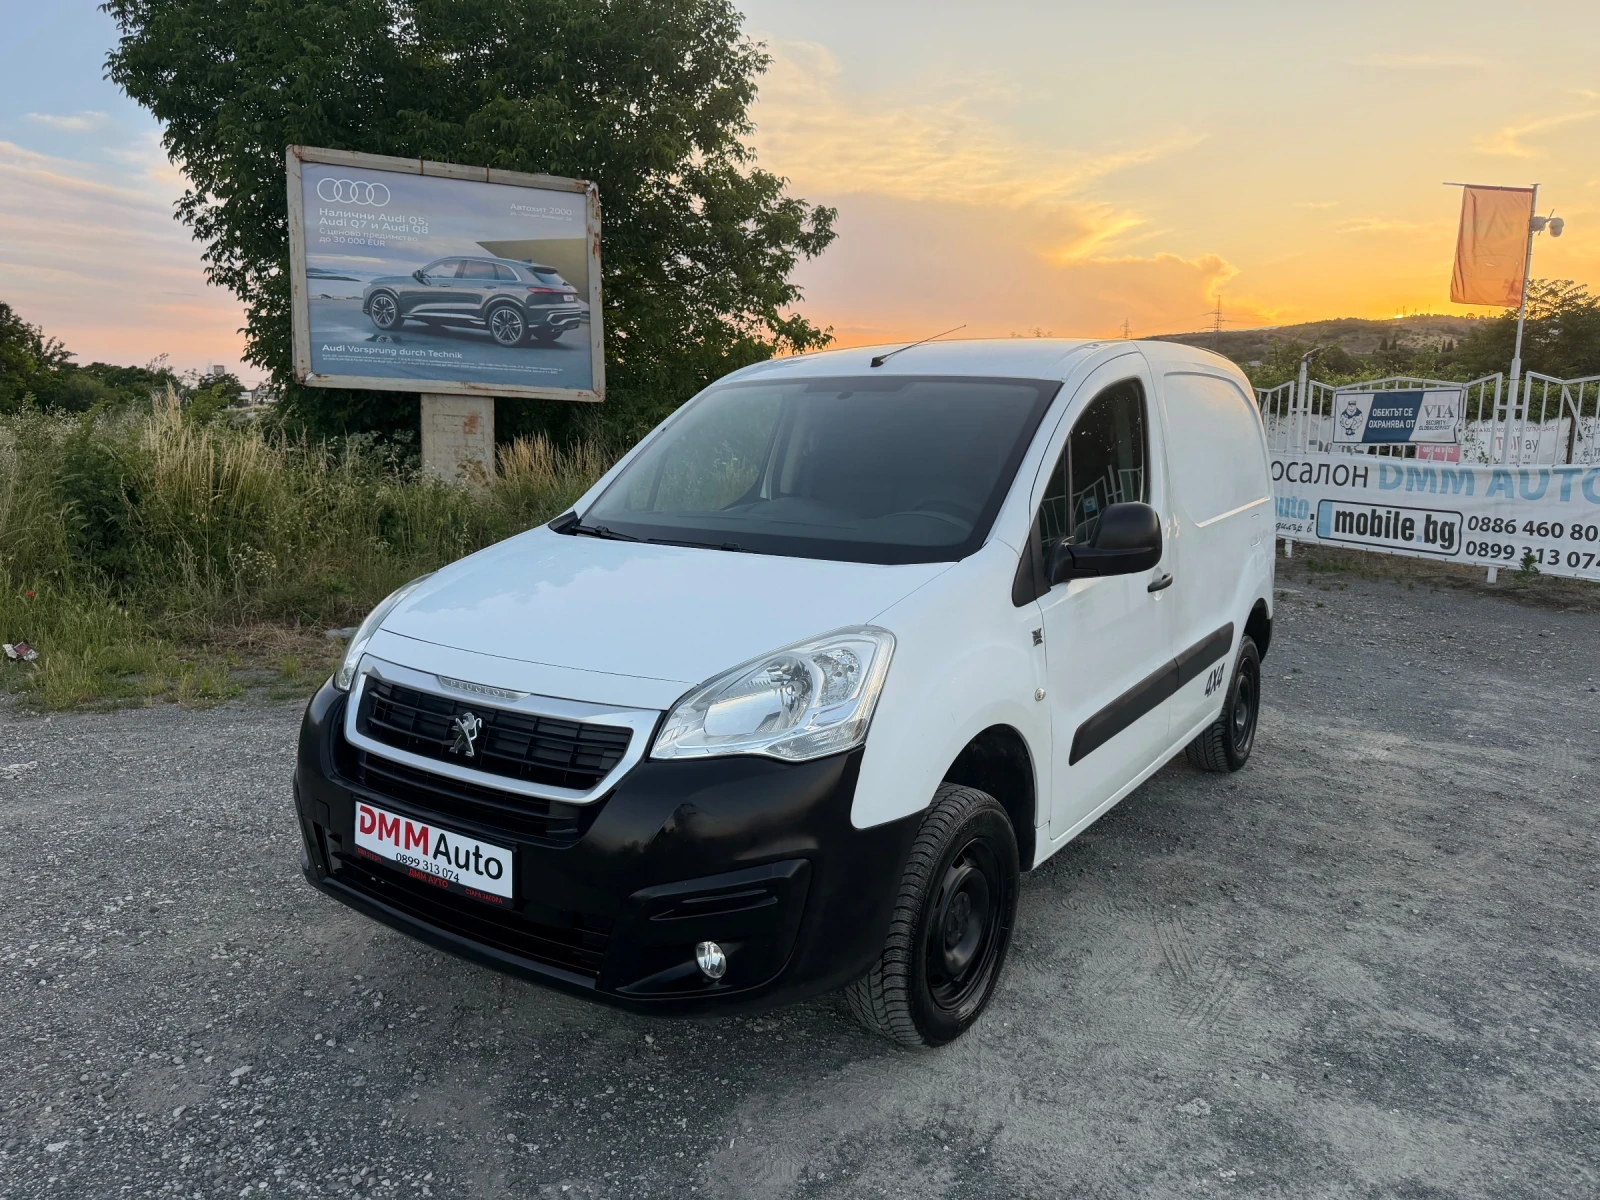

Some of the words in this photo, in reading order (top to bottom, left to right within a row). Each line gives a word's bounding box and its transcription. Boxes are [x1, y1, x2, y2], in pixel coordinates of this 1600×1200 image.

[319, 207, 375, 220] Налични
[378, 213, 406, 223] Audi
[408, 216, 429, 226] Q5,
[510, 203, 547, 213] Автохит
[549, 207, 573, 216] 2000
[319, 217, 347, 226] Audi
[350, 219, 367, 228] Q7
[382, 222, 409, 232] Audi
[412, 225, 429, 234] Q8
[327, 229, 361, 237] ценово
[363, 231, 418, 242] предимство
[347, 237, 366, 245] 000
[367, 237, 386, 247] EUR
[322, 344, 345, 352] Audi
[347, 345, 397, 356] Vorsprung
[399, 348, 426, 356] durch
[428, 350, 463, 359] Technik
[1372, 408, 1402, 417] ОБЕКТЪТ
[1403, 407, 1413, 417] СЕ
[1423, 404, 1455, 418] VTA
[1368, 420, 1404, 428] ОХРАНЯВА
[1405, 420, 1416, 428] ОТ
[1271, 460, 1369, 488] осалон
[1378, 463, 1475, 497] DMM
[1334, 508, 1456, 550] mobile.bg
[1467, 515, 1517, 534] 0886
[1521, 520, 1564, 539] 460
[1569, 523, 1600, 542] 80
[1465, 540, 1515, 560] 0899
[450, 680, 509, 698] PEUGEOT
[395, 852, 420, 867] 0899
[422, 860, 440, 875] 313
[442, 867, 460, 882] 074
[408, 867, 427, 881] ДММ
[428, 875, 448, 888] АУТО
